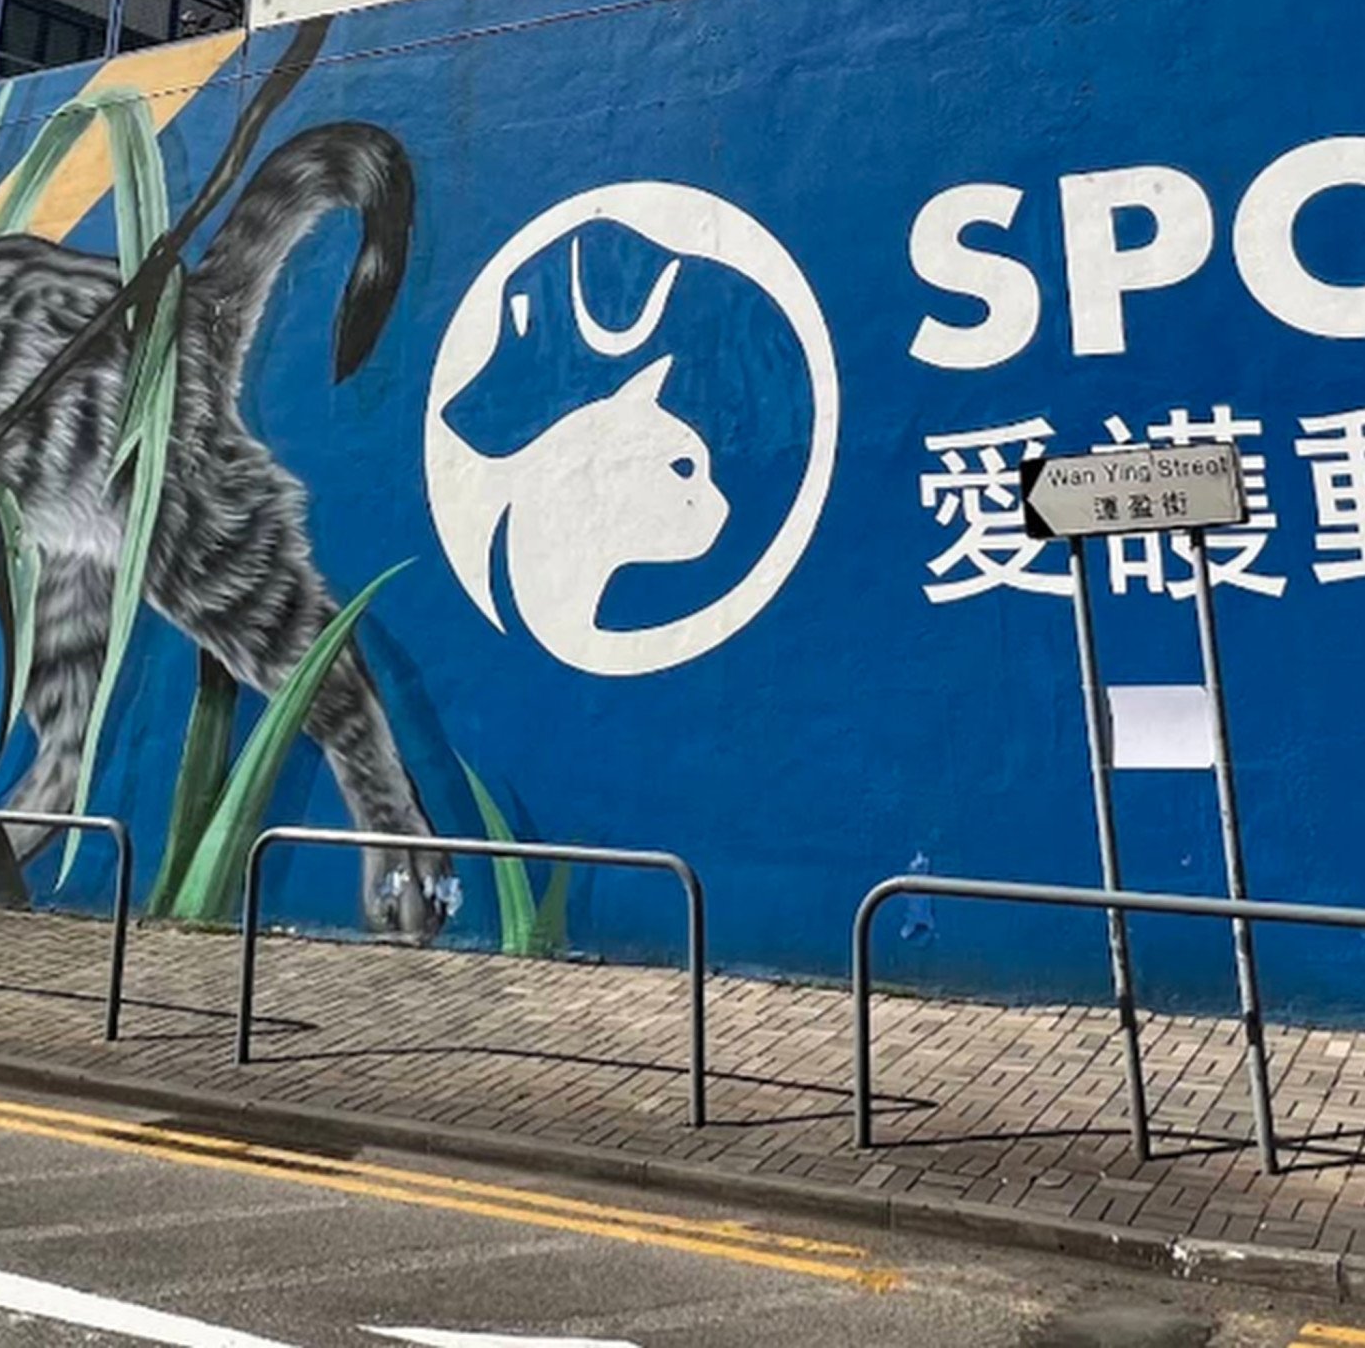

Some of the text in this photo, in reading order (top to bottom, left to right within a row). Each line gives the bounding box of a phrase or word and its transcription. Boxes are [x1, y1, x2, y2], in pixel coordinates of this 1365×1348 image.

[1047, 456, 1229, 487] Wan Ying Street
